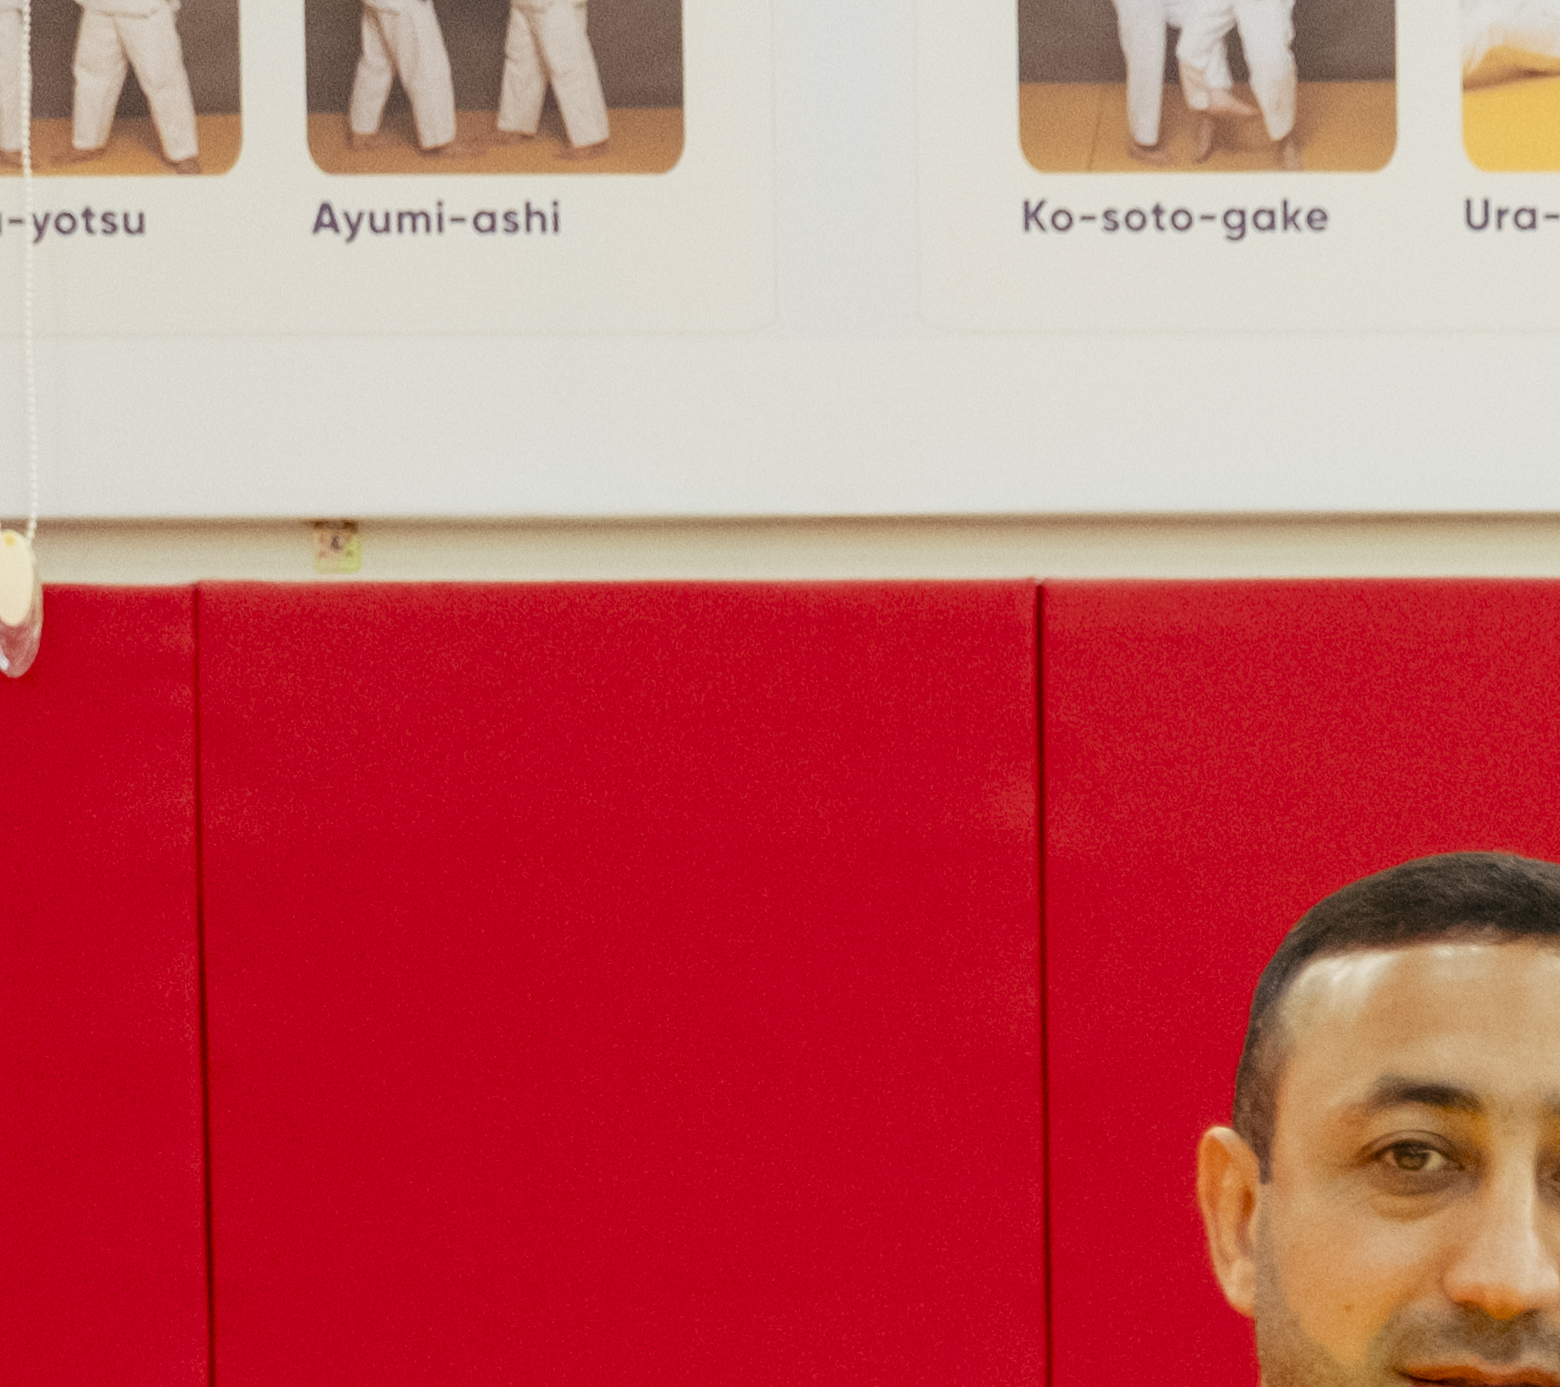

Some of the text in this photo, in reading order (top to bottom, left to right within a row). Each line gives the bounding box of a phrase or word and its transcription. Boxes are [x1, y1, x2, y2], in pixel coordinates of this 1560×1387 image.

[0, 206, 145, 244] -yotsu
[312, 200, 561, 243] Ayumi-ashi
[1023, 199, 1329, 242] Ko-soto-gake
